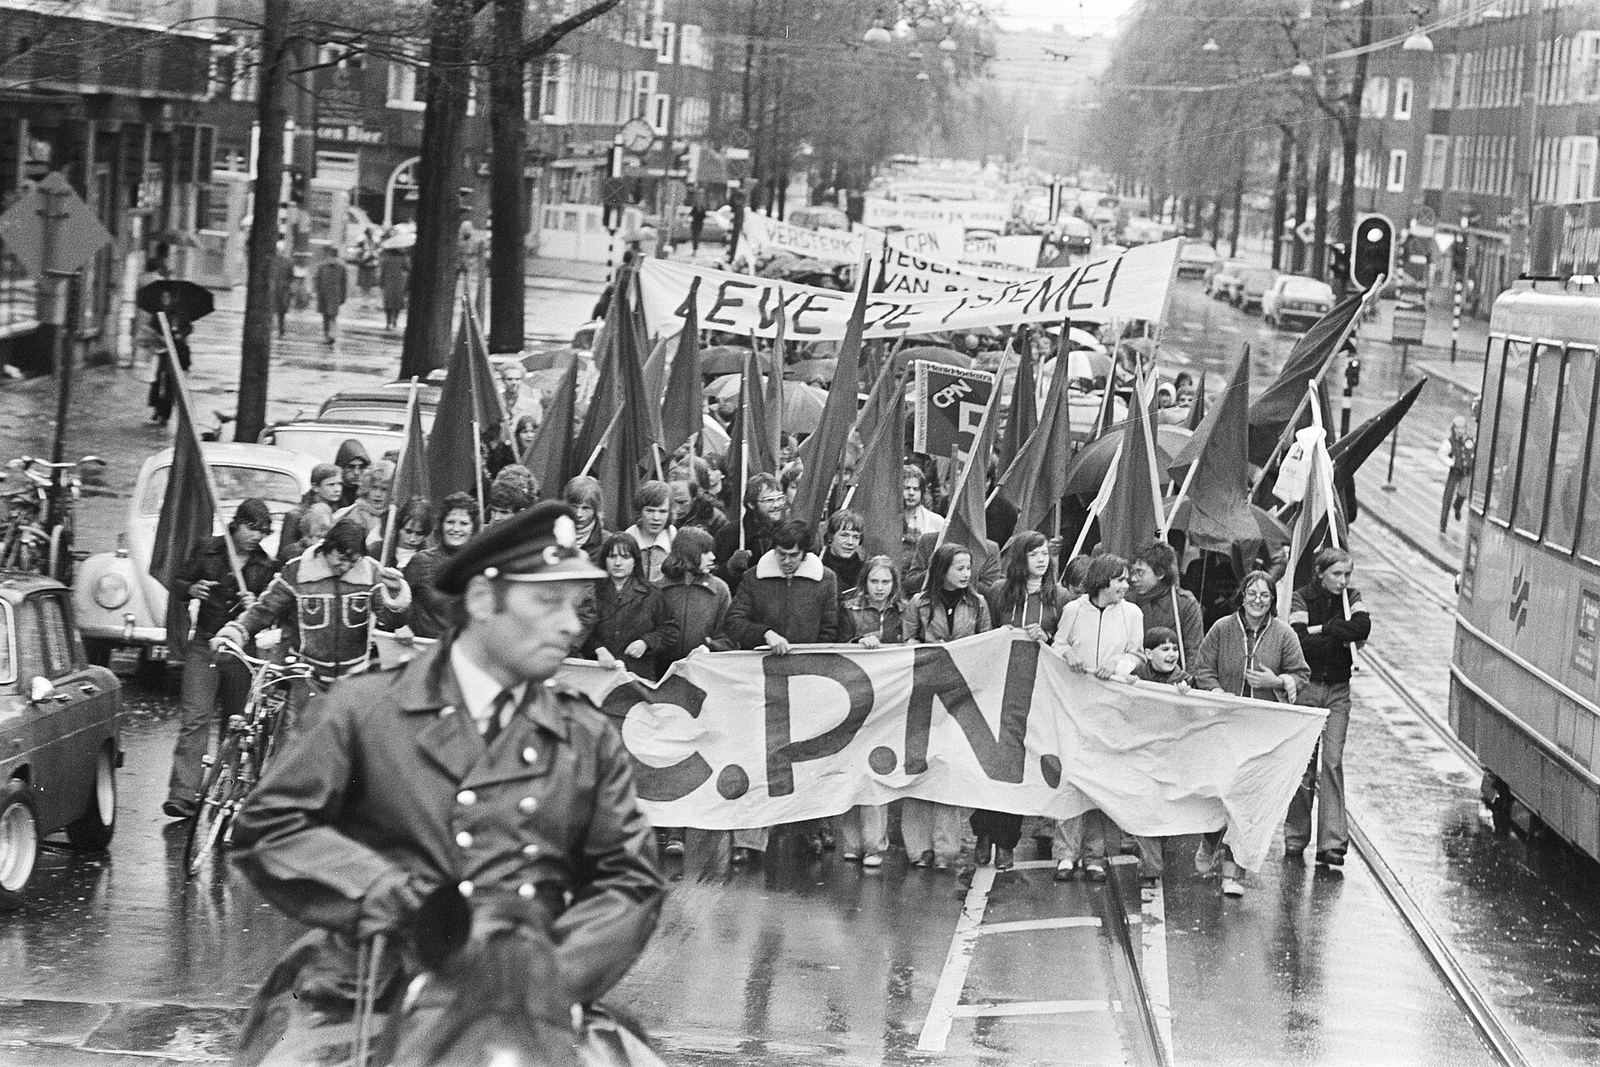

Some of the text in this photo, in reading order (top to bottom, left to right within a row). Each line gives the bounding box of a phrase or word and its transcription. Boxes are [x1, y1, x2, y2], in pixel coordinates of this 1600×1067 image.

[673, 275, 847, 334] LEVE
[1022, 255, 1124, 314] MEI
[932, 378, 973, 408] CPN
[600, 639, 1062, 802] C.P.N.
